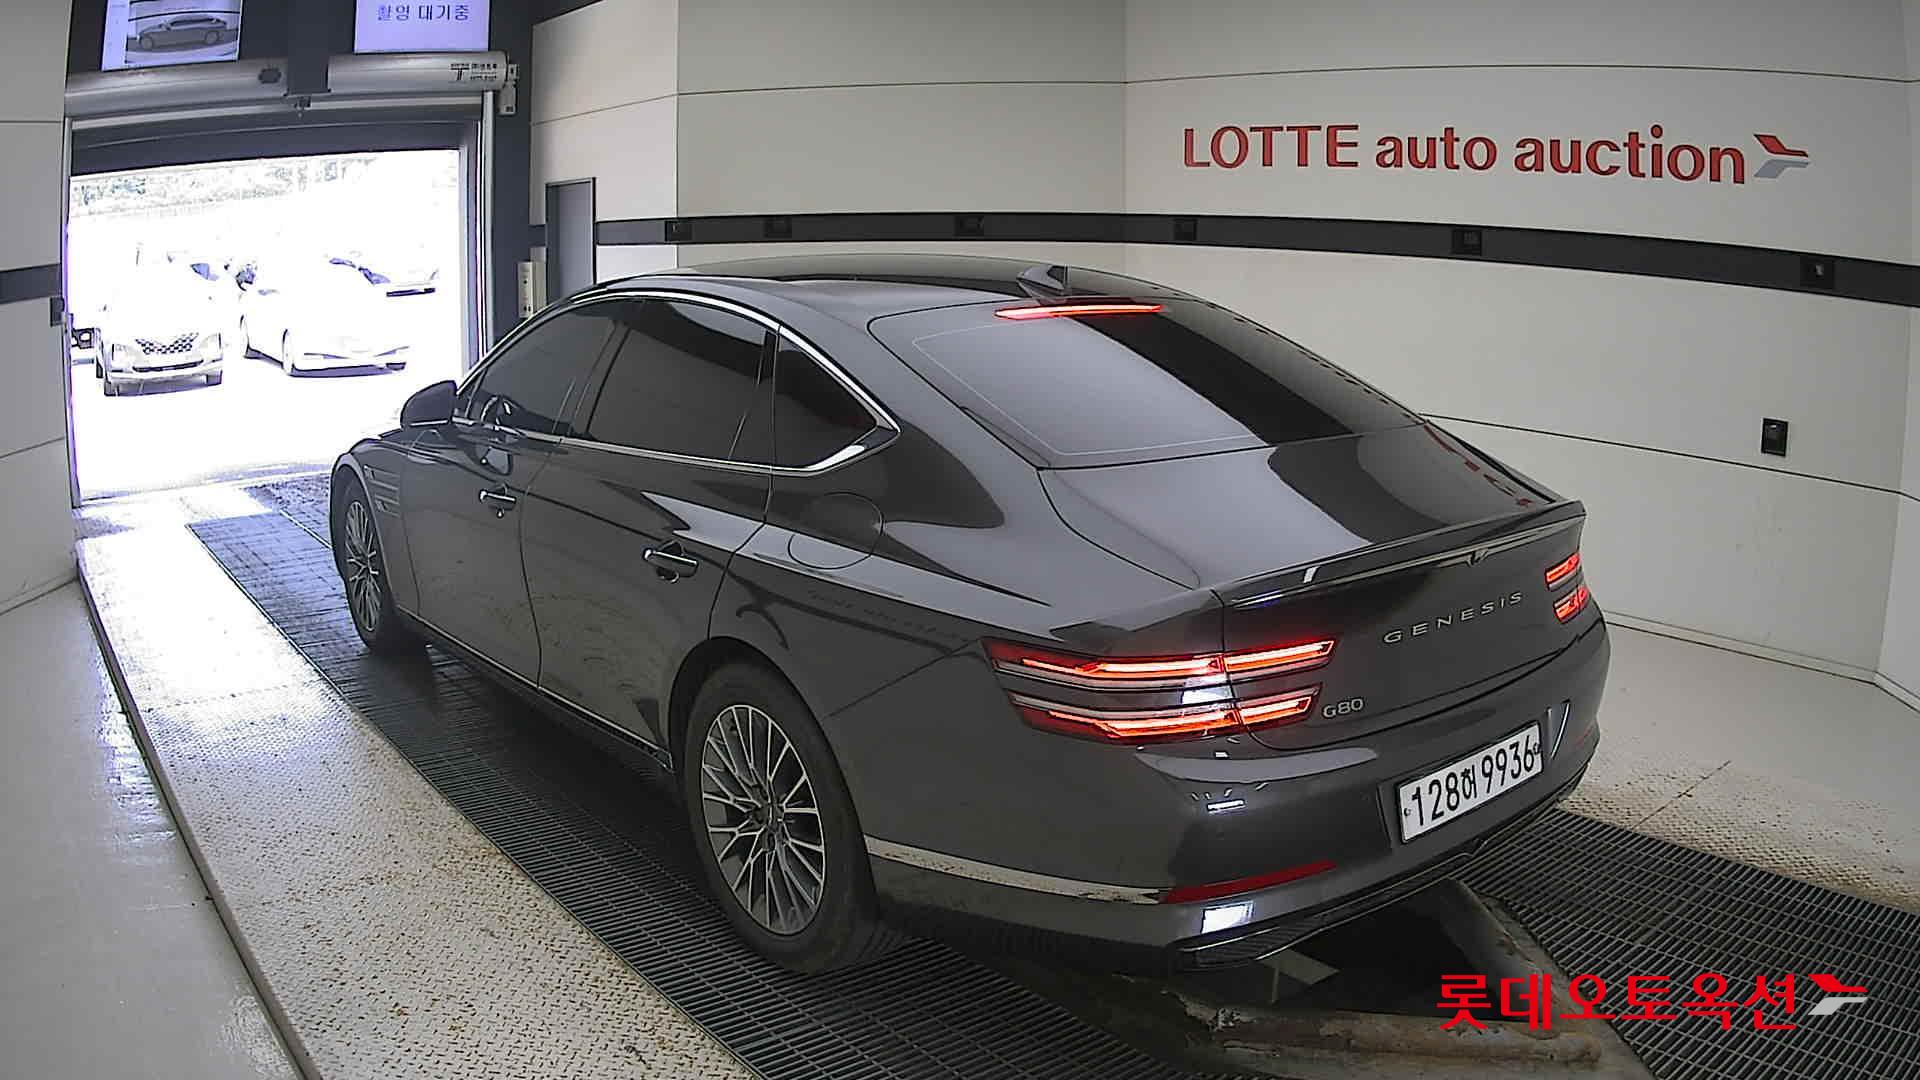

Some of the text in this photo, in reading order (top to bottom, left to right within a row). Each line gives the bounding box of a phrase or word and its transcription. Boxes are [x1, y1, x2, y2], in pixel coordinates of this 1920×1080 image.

[418, 4, 470, 21] 대기중
[1183, 125, 1745, 184] LOTTE auto auction
[1383, 591, 1523, 644] GENESIS
[1322, 698, 1365, 719] G80
